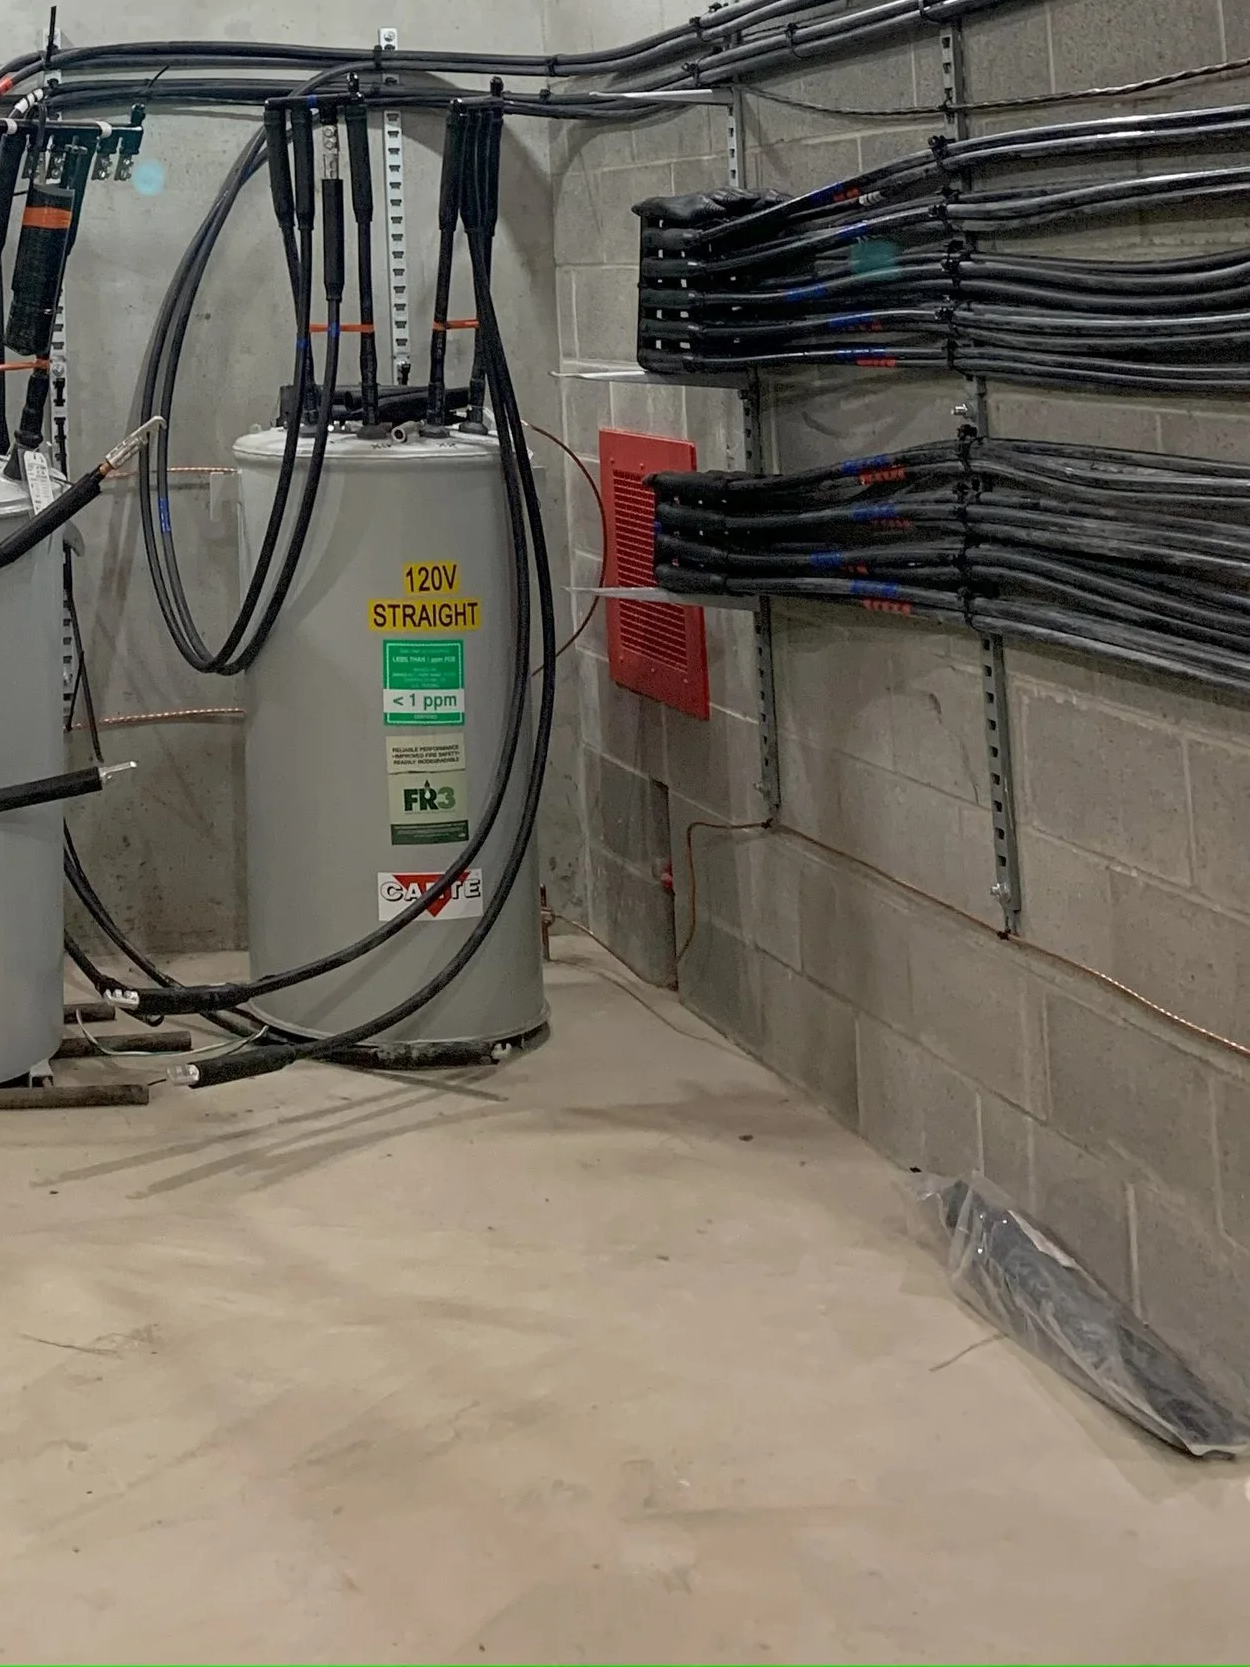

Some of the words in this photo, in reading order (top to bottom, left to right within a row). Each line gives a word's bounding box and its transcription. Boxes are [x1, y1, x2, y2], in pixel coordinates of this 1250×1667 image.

[406, 564, 457, 592] 120V
[373, 602, 478, 627] STRAIGHT
[393, 696, 404, 706] <
[409, 693, 415, 706] 1
[423, 695, 457, 711] ppm
[403, 786, 456, 811] FR3
[380, 879, 481, 901] CATE
